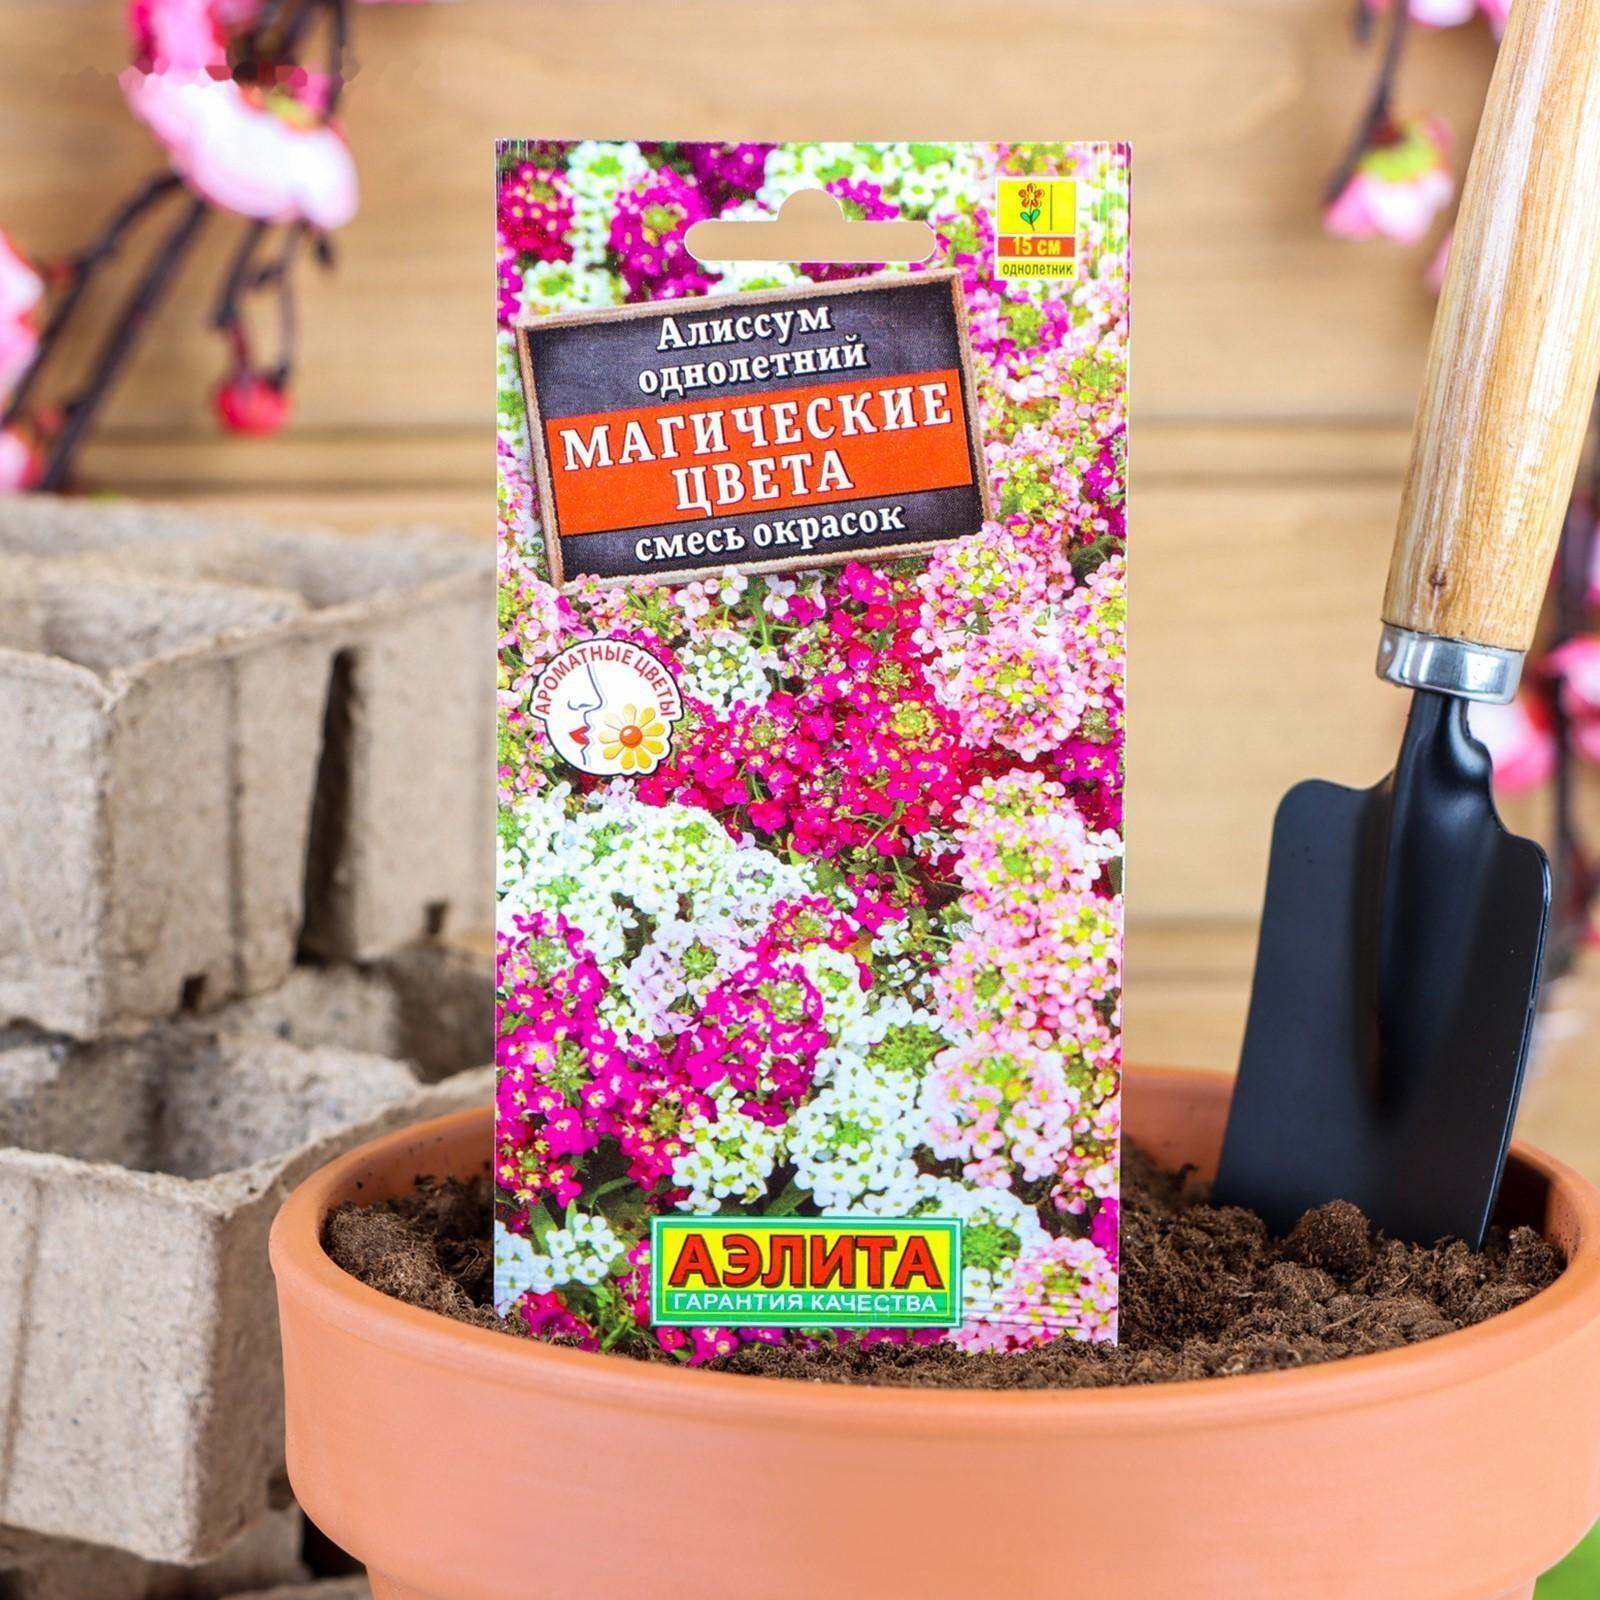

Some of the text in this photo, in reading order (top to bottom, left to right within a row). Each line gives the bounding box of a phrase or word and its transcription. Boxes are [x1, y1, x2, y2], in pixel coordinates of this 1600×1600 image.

[1002, 263, 1073, 277] однолетник
[1013, 237, 1061, 255] 15 см
[656, 306, 832, 351] Алиссум
[638, 335, 867, 398] однолетний
[560, 382, 953, 471] МАГИЧЕСКИЕ
[672, 450, 855, 517] ЦВЕТА
[635, 505, 905, 563] смесь окрасок
[535, 645, 676, 716] АРОМАТНЫЕ ЦВЕТЫ
[668, 1233, 945, 1290] АЭЛИТА
[673, 1293, 938, 1313] ГАРАНТИЯ КАЧЕСТВА
